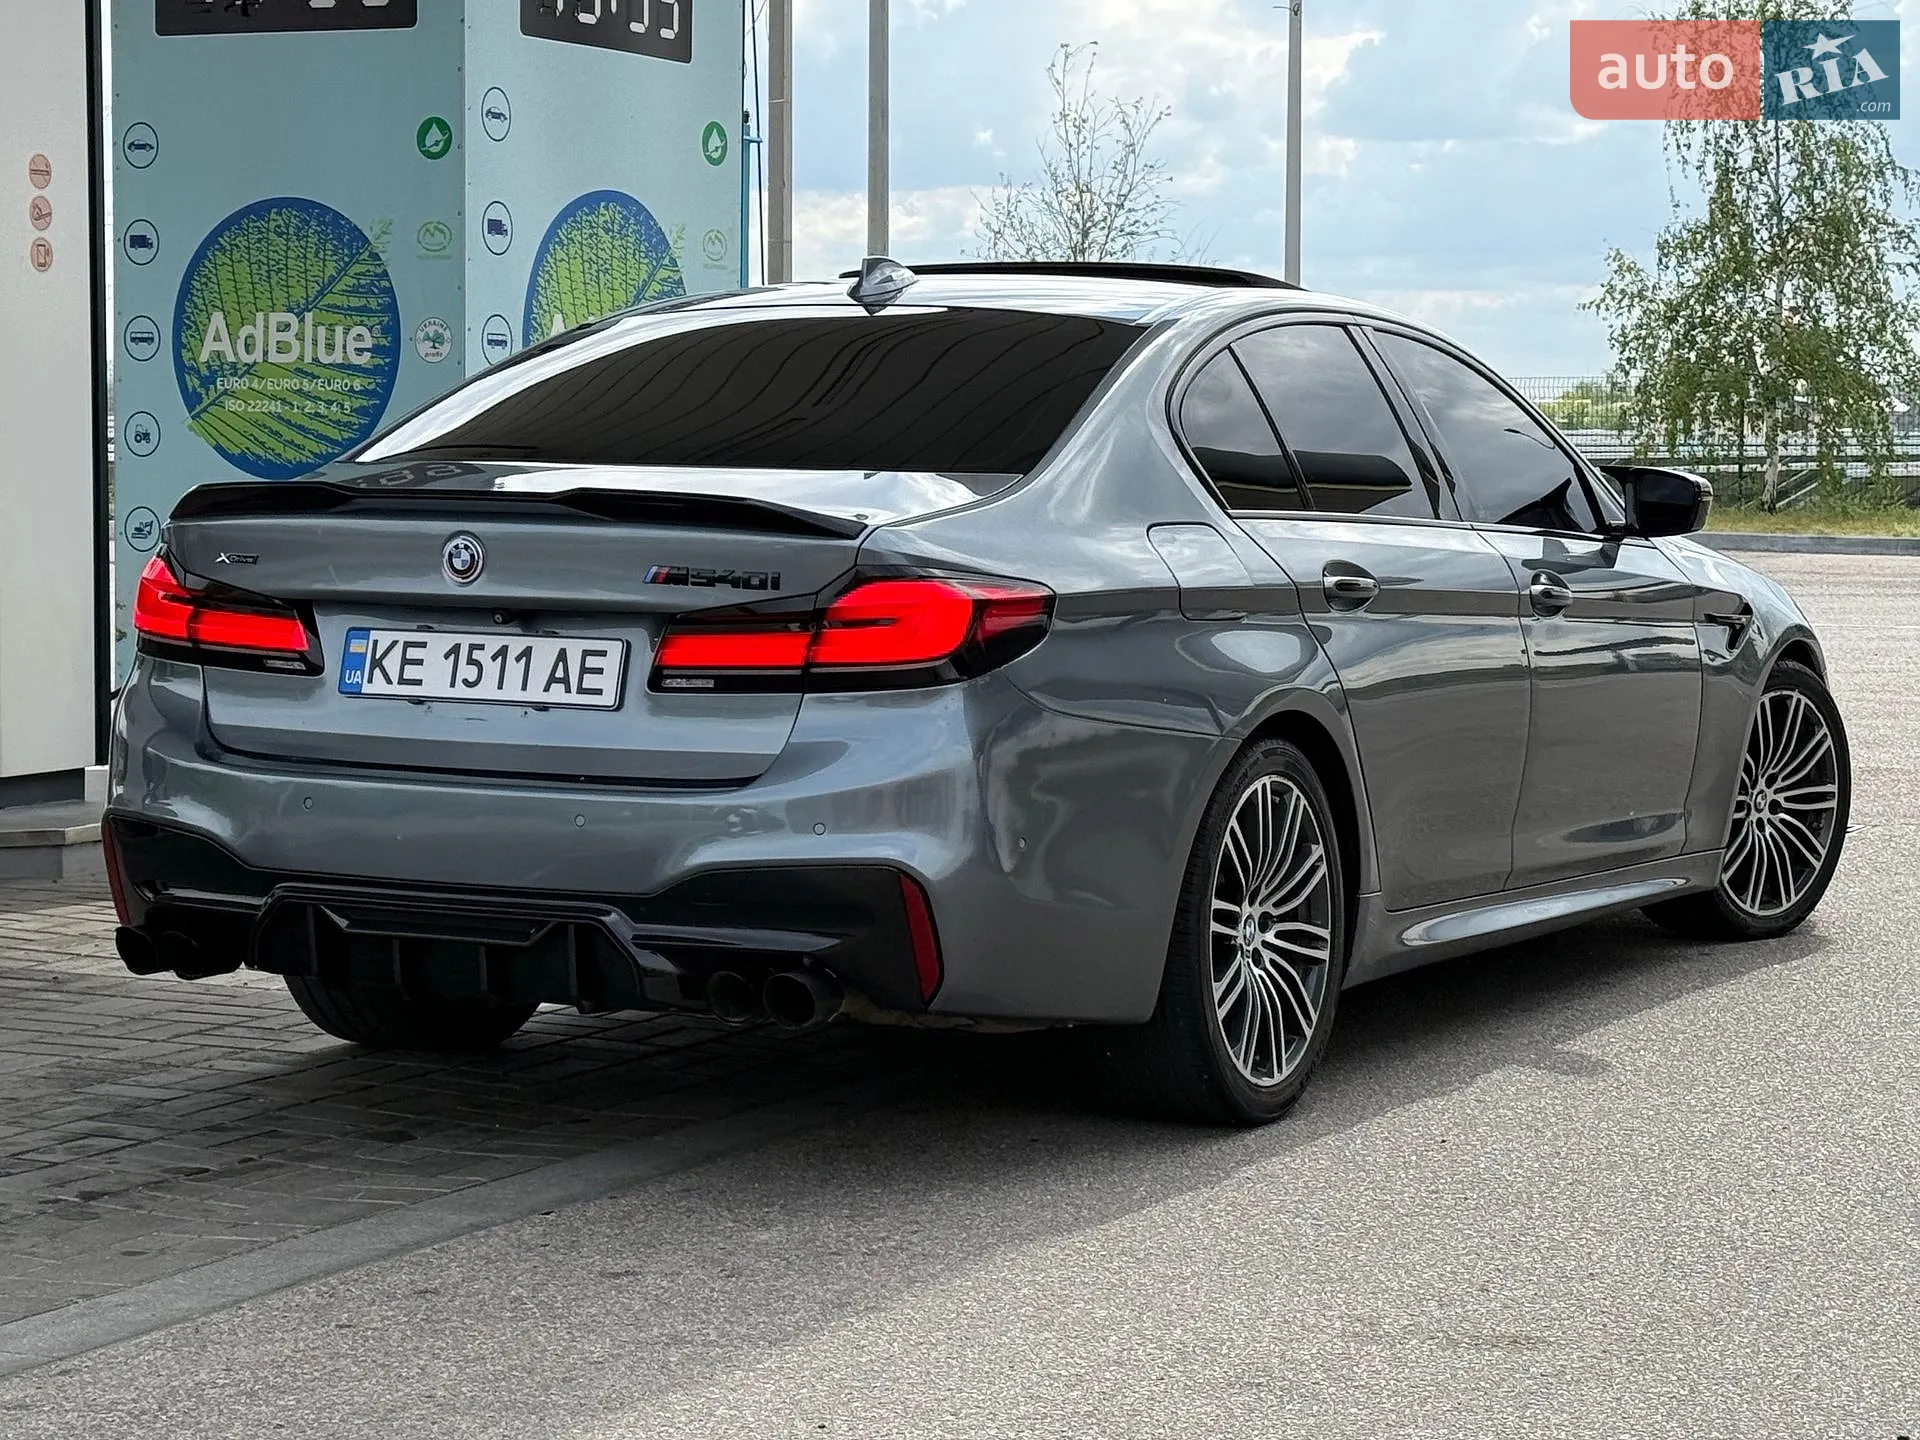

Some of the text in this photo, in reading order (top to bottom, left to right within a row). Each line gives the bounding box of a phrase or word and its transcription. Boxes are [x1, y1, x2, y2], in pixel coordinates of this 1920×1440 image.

[216, 377, 249, 389] EURO
[353, 379, 361, 391] 6
[224, 399, 245, 411] ISO
[247, 400, 282, 412] 22241
[366, 639, 608, 696] KE 1511 AE
[345, 669, 362, 684] UA
